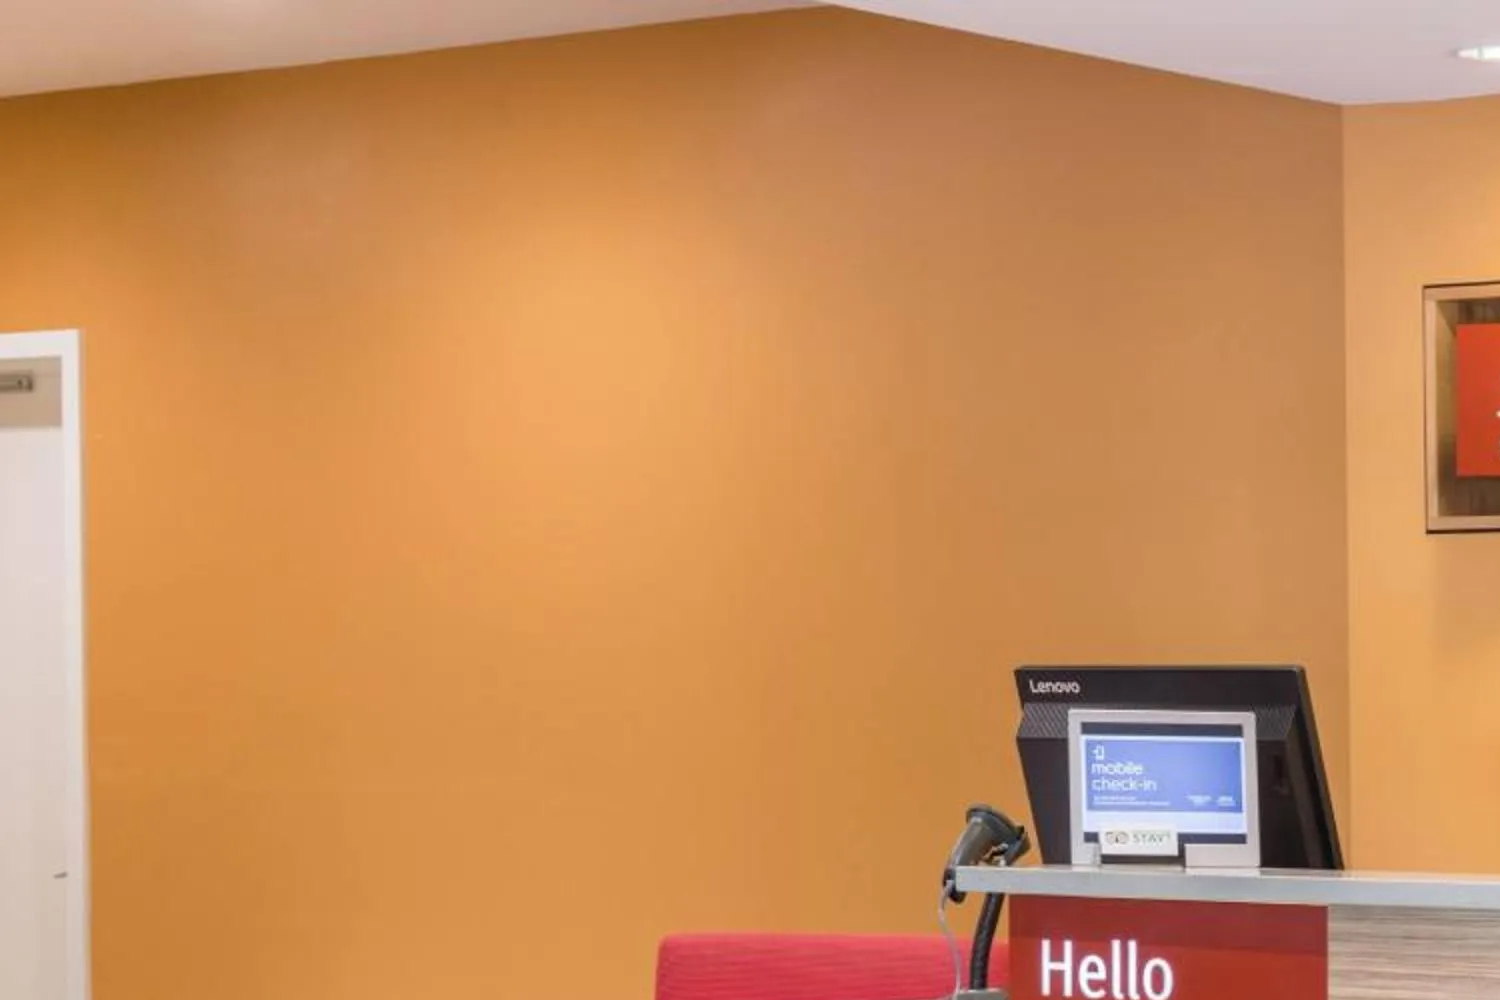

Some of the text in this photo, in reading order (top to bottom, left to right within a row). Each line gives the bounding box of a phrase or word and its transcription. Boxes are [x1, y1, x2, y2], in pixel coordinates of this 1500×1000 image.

[1029, 679, 1081, 693] Lenovo
[1091, 761, 1143, 775] mobile
[1091, 777, 1157, 792] check-in
